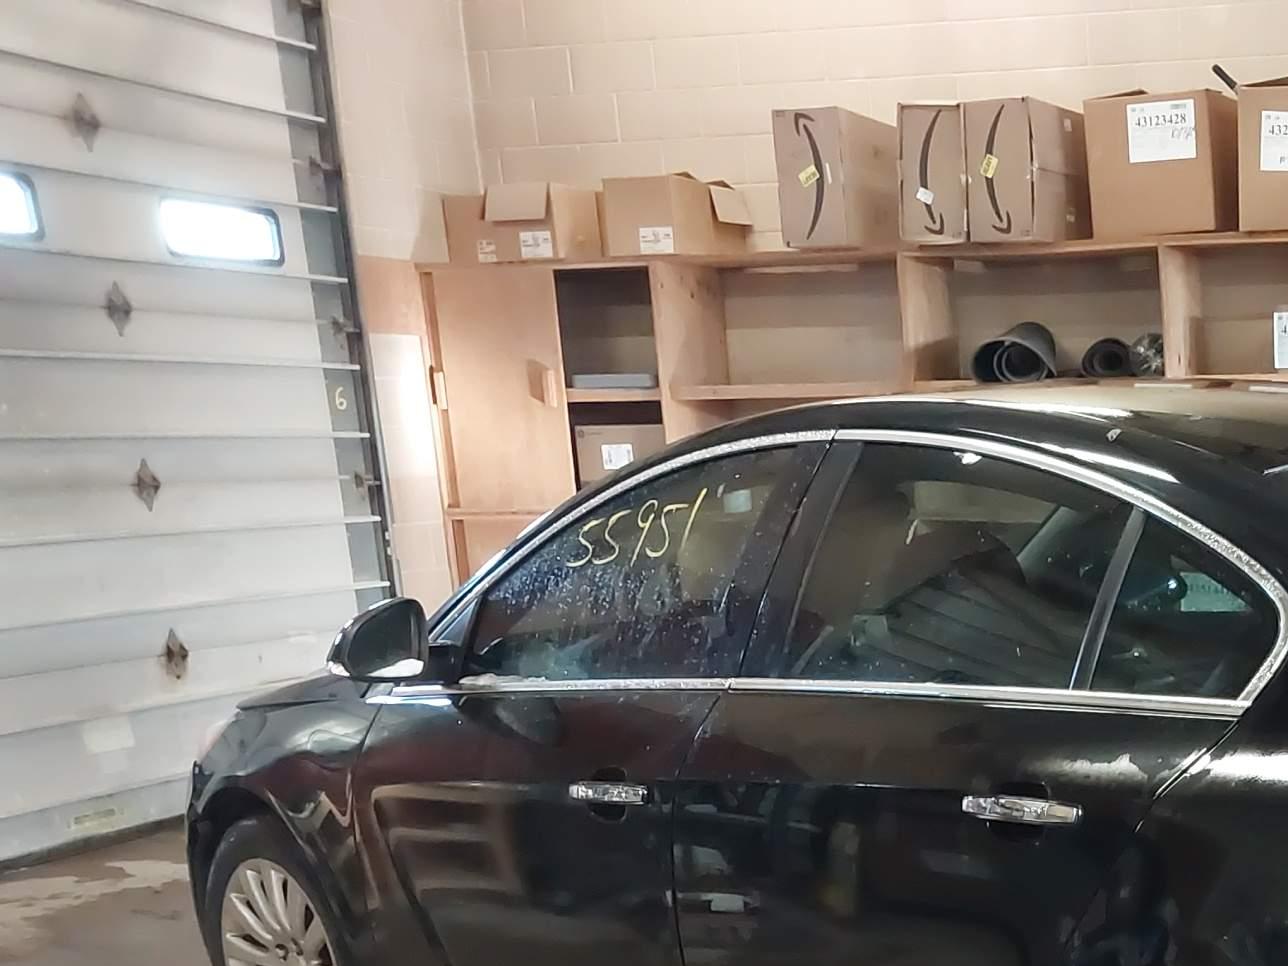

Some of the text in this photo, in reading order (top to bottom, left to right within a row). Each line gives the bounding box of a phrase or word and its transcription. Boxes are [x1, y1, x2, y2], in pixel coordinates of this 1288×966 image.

[1135, 113, 1186, 127] 43123428
[335, 386, 347, 410] 6
[565, 488, 708, 568] 55951
